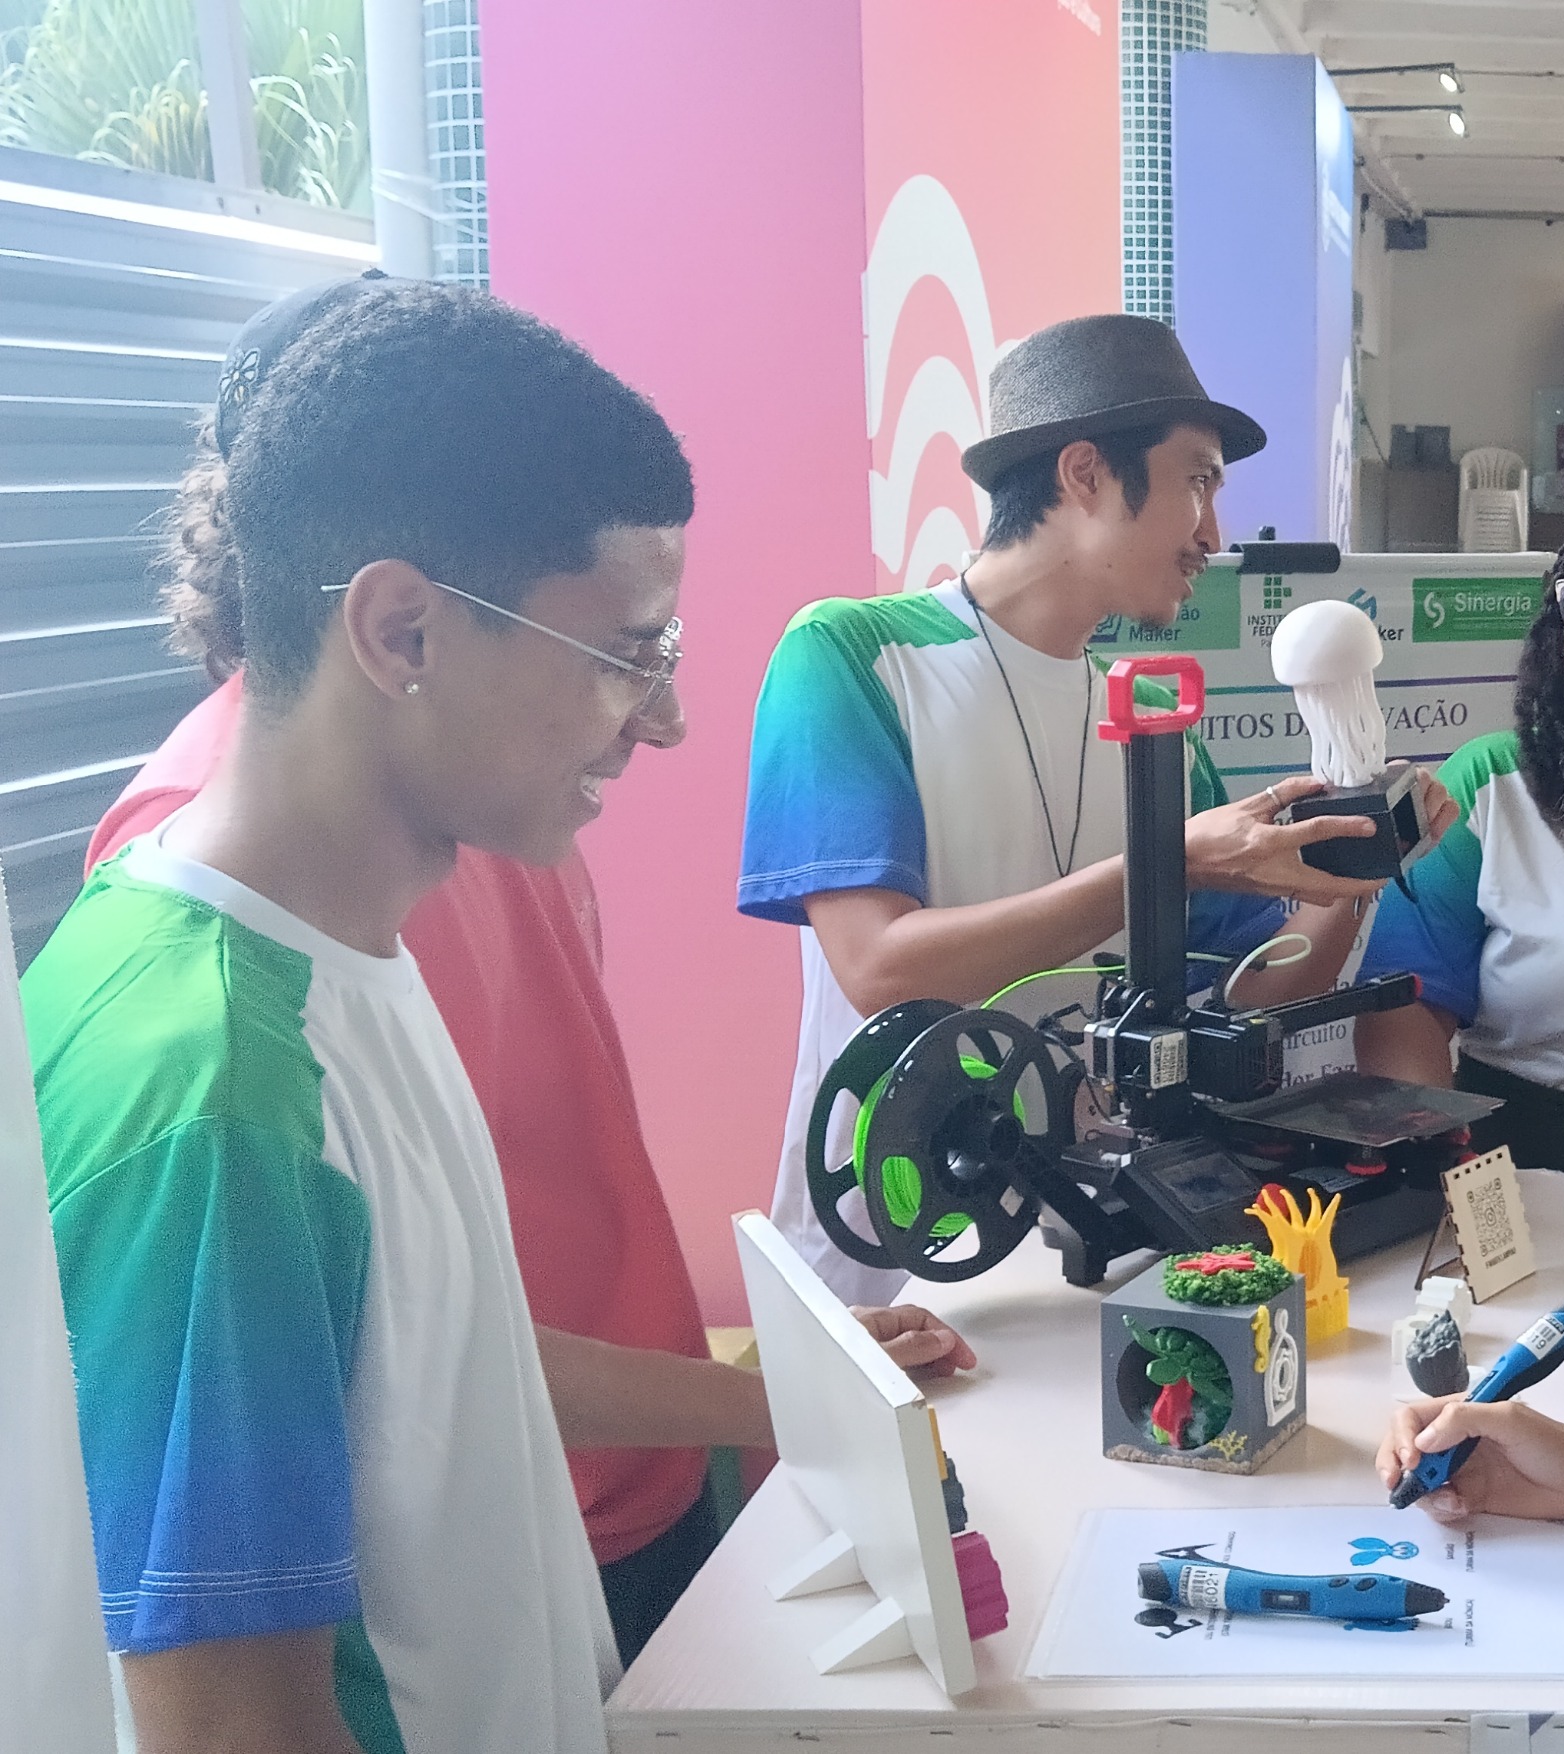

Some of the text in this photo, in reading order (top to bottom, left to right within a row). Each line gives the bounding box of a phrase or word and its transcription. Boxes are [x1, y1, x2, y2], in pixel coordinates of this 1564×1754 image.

[1454, 592, 1532, 616] Sinergia
[1129, 625, 1182, 642] Maker
[1253, 626, 1277, 637] FED
[1378, 624, 1404, 641] ker
[1381, 699, 1468, 733] VAÇÃO
[1284, 1023, 1347, 1050] ircuito
